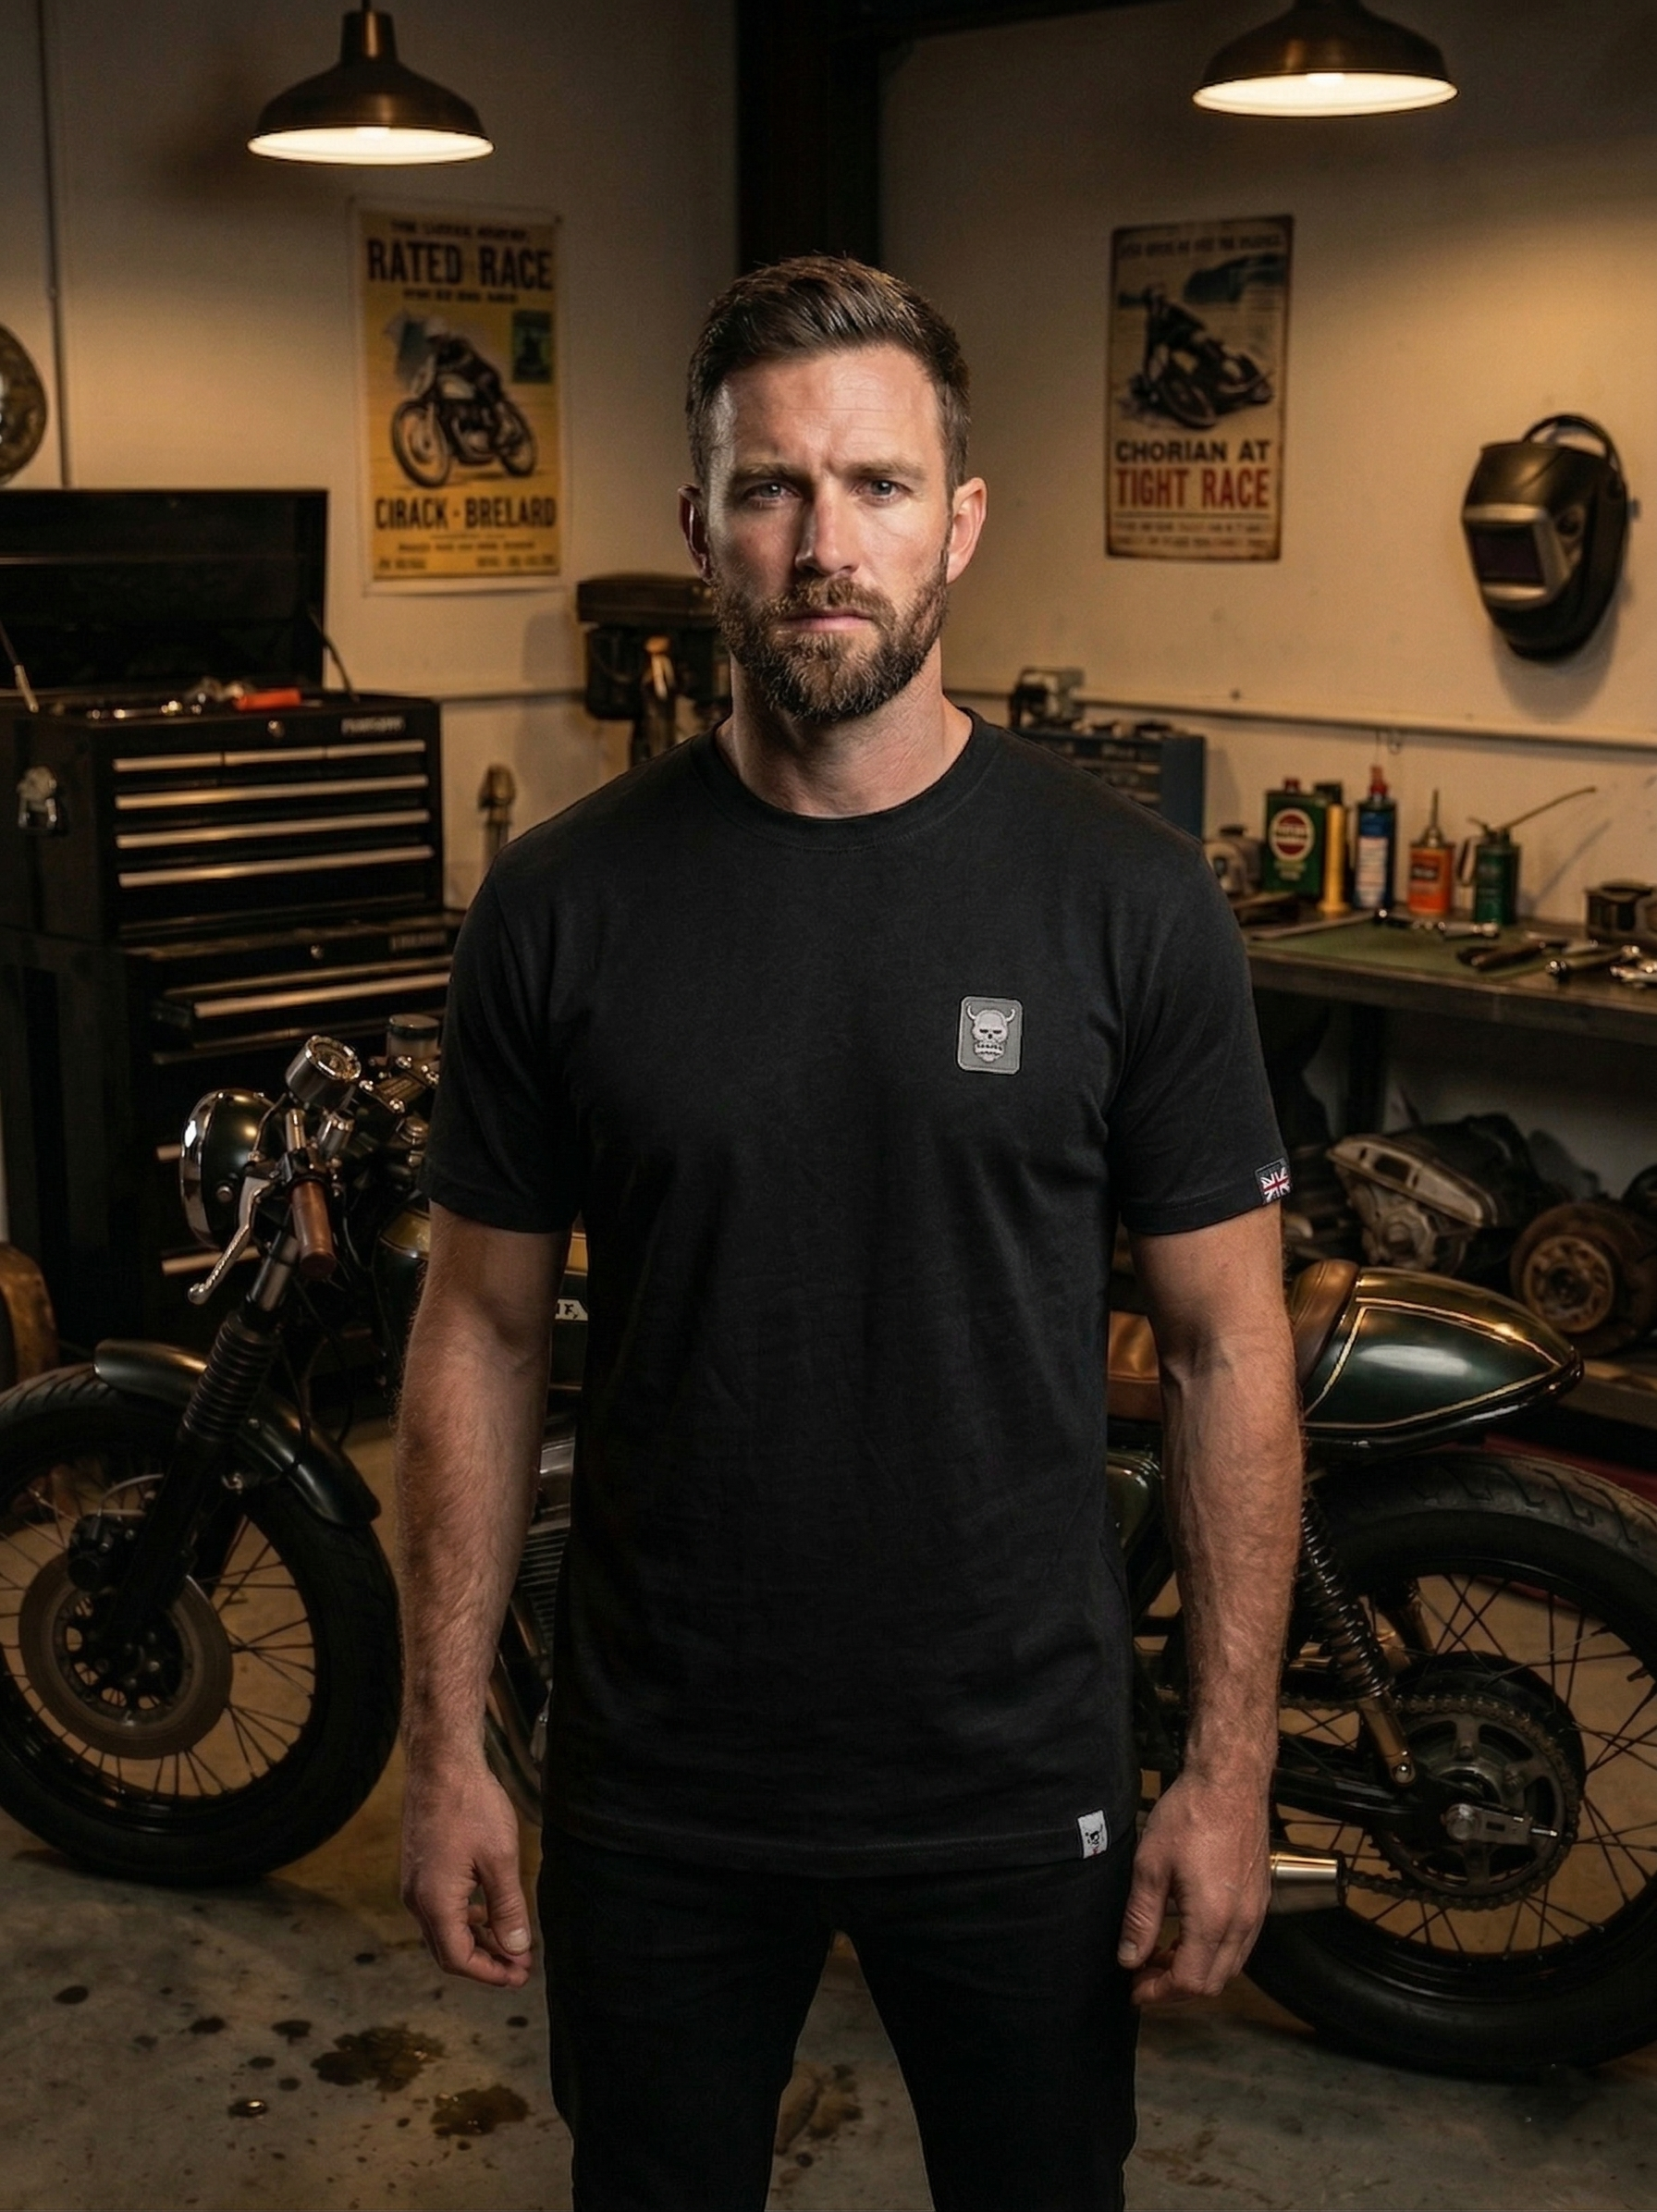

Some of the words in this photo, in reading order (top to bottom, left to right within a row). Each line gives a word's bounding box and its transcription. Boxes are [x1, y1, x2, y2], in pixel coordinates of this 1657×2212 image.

[368, 239, 460, 283] RATED
[481, 245, 552, 289] RACE
[1116, 441, 1226, 462] CHORIAN
[1239, 441, 1270, 461] AT
[1117, 469, 1189, 508] TIGHT
[1202, 469, 1270, 508] RACE
[465, 497, 556, 528] BRELARD
